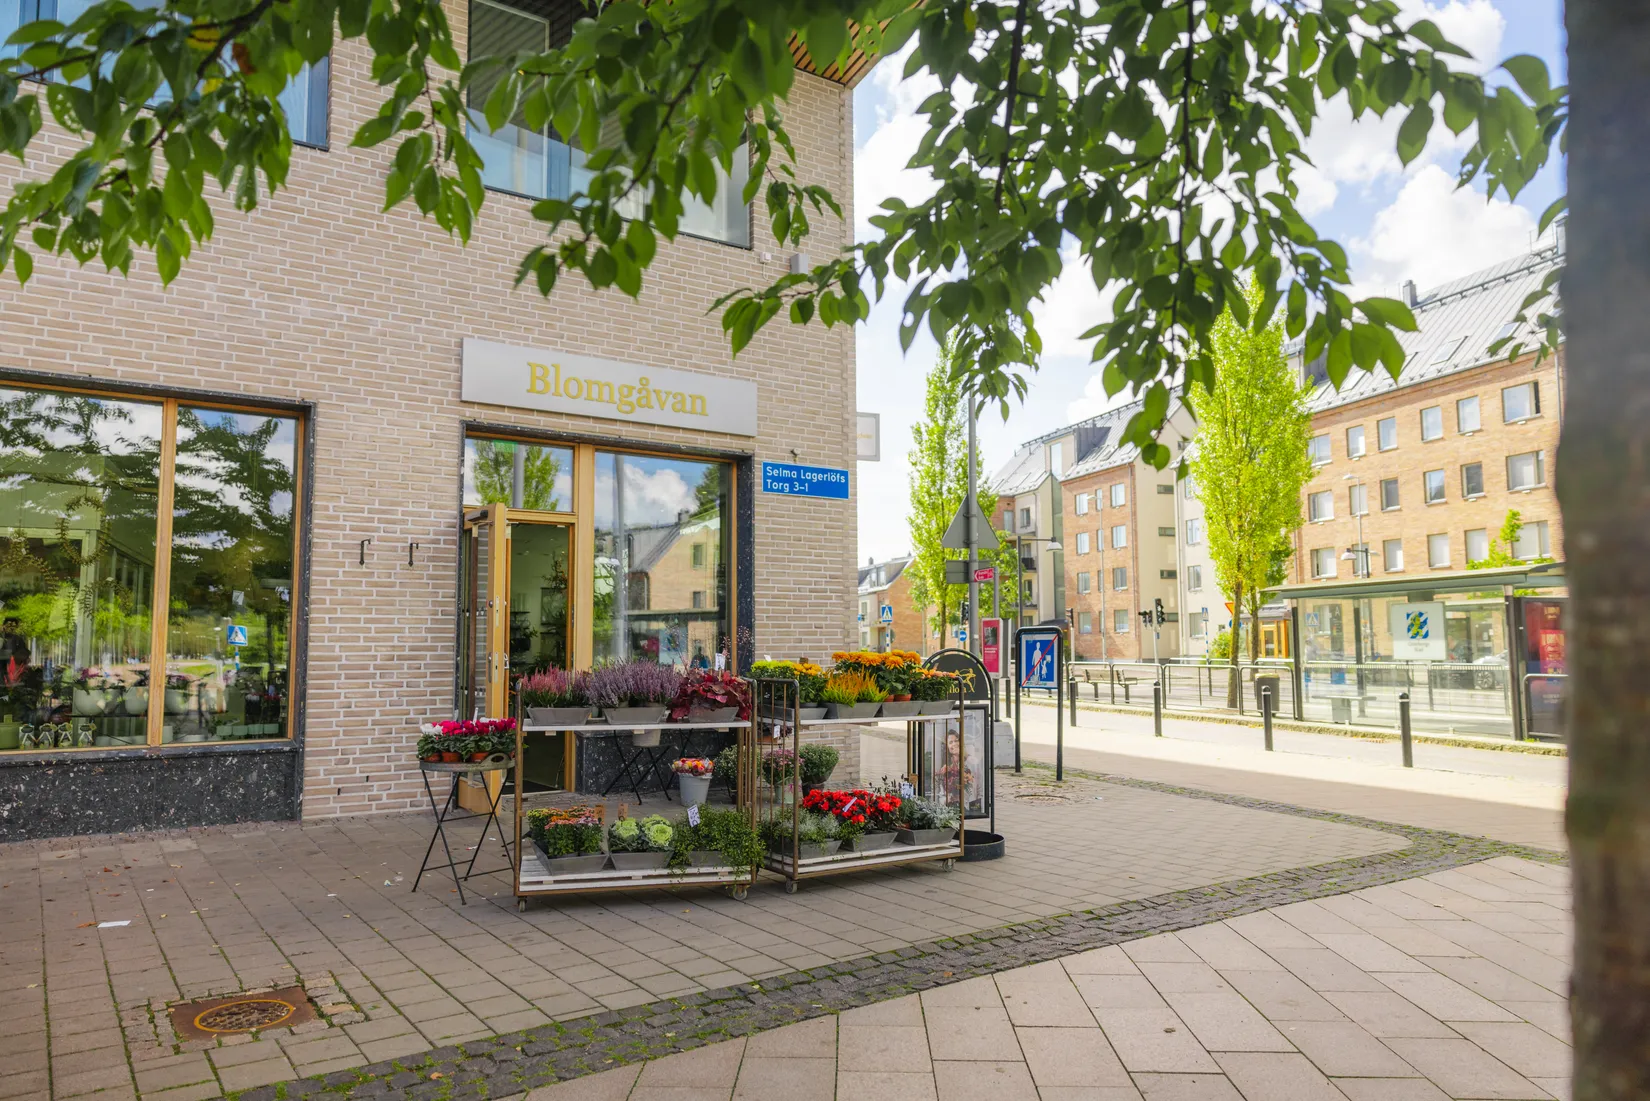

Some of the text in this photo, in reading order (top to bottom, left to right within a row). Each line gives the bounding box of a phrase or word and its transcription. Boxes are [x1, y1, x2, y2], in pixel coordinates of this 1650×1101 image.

[526, 361, 709, 416] Blomgåvan
[766, 466, 846, 483] Selma Lagerlöfs
[766, 479, 809, 493] Torg 3-1
